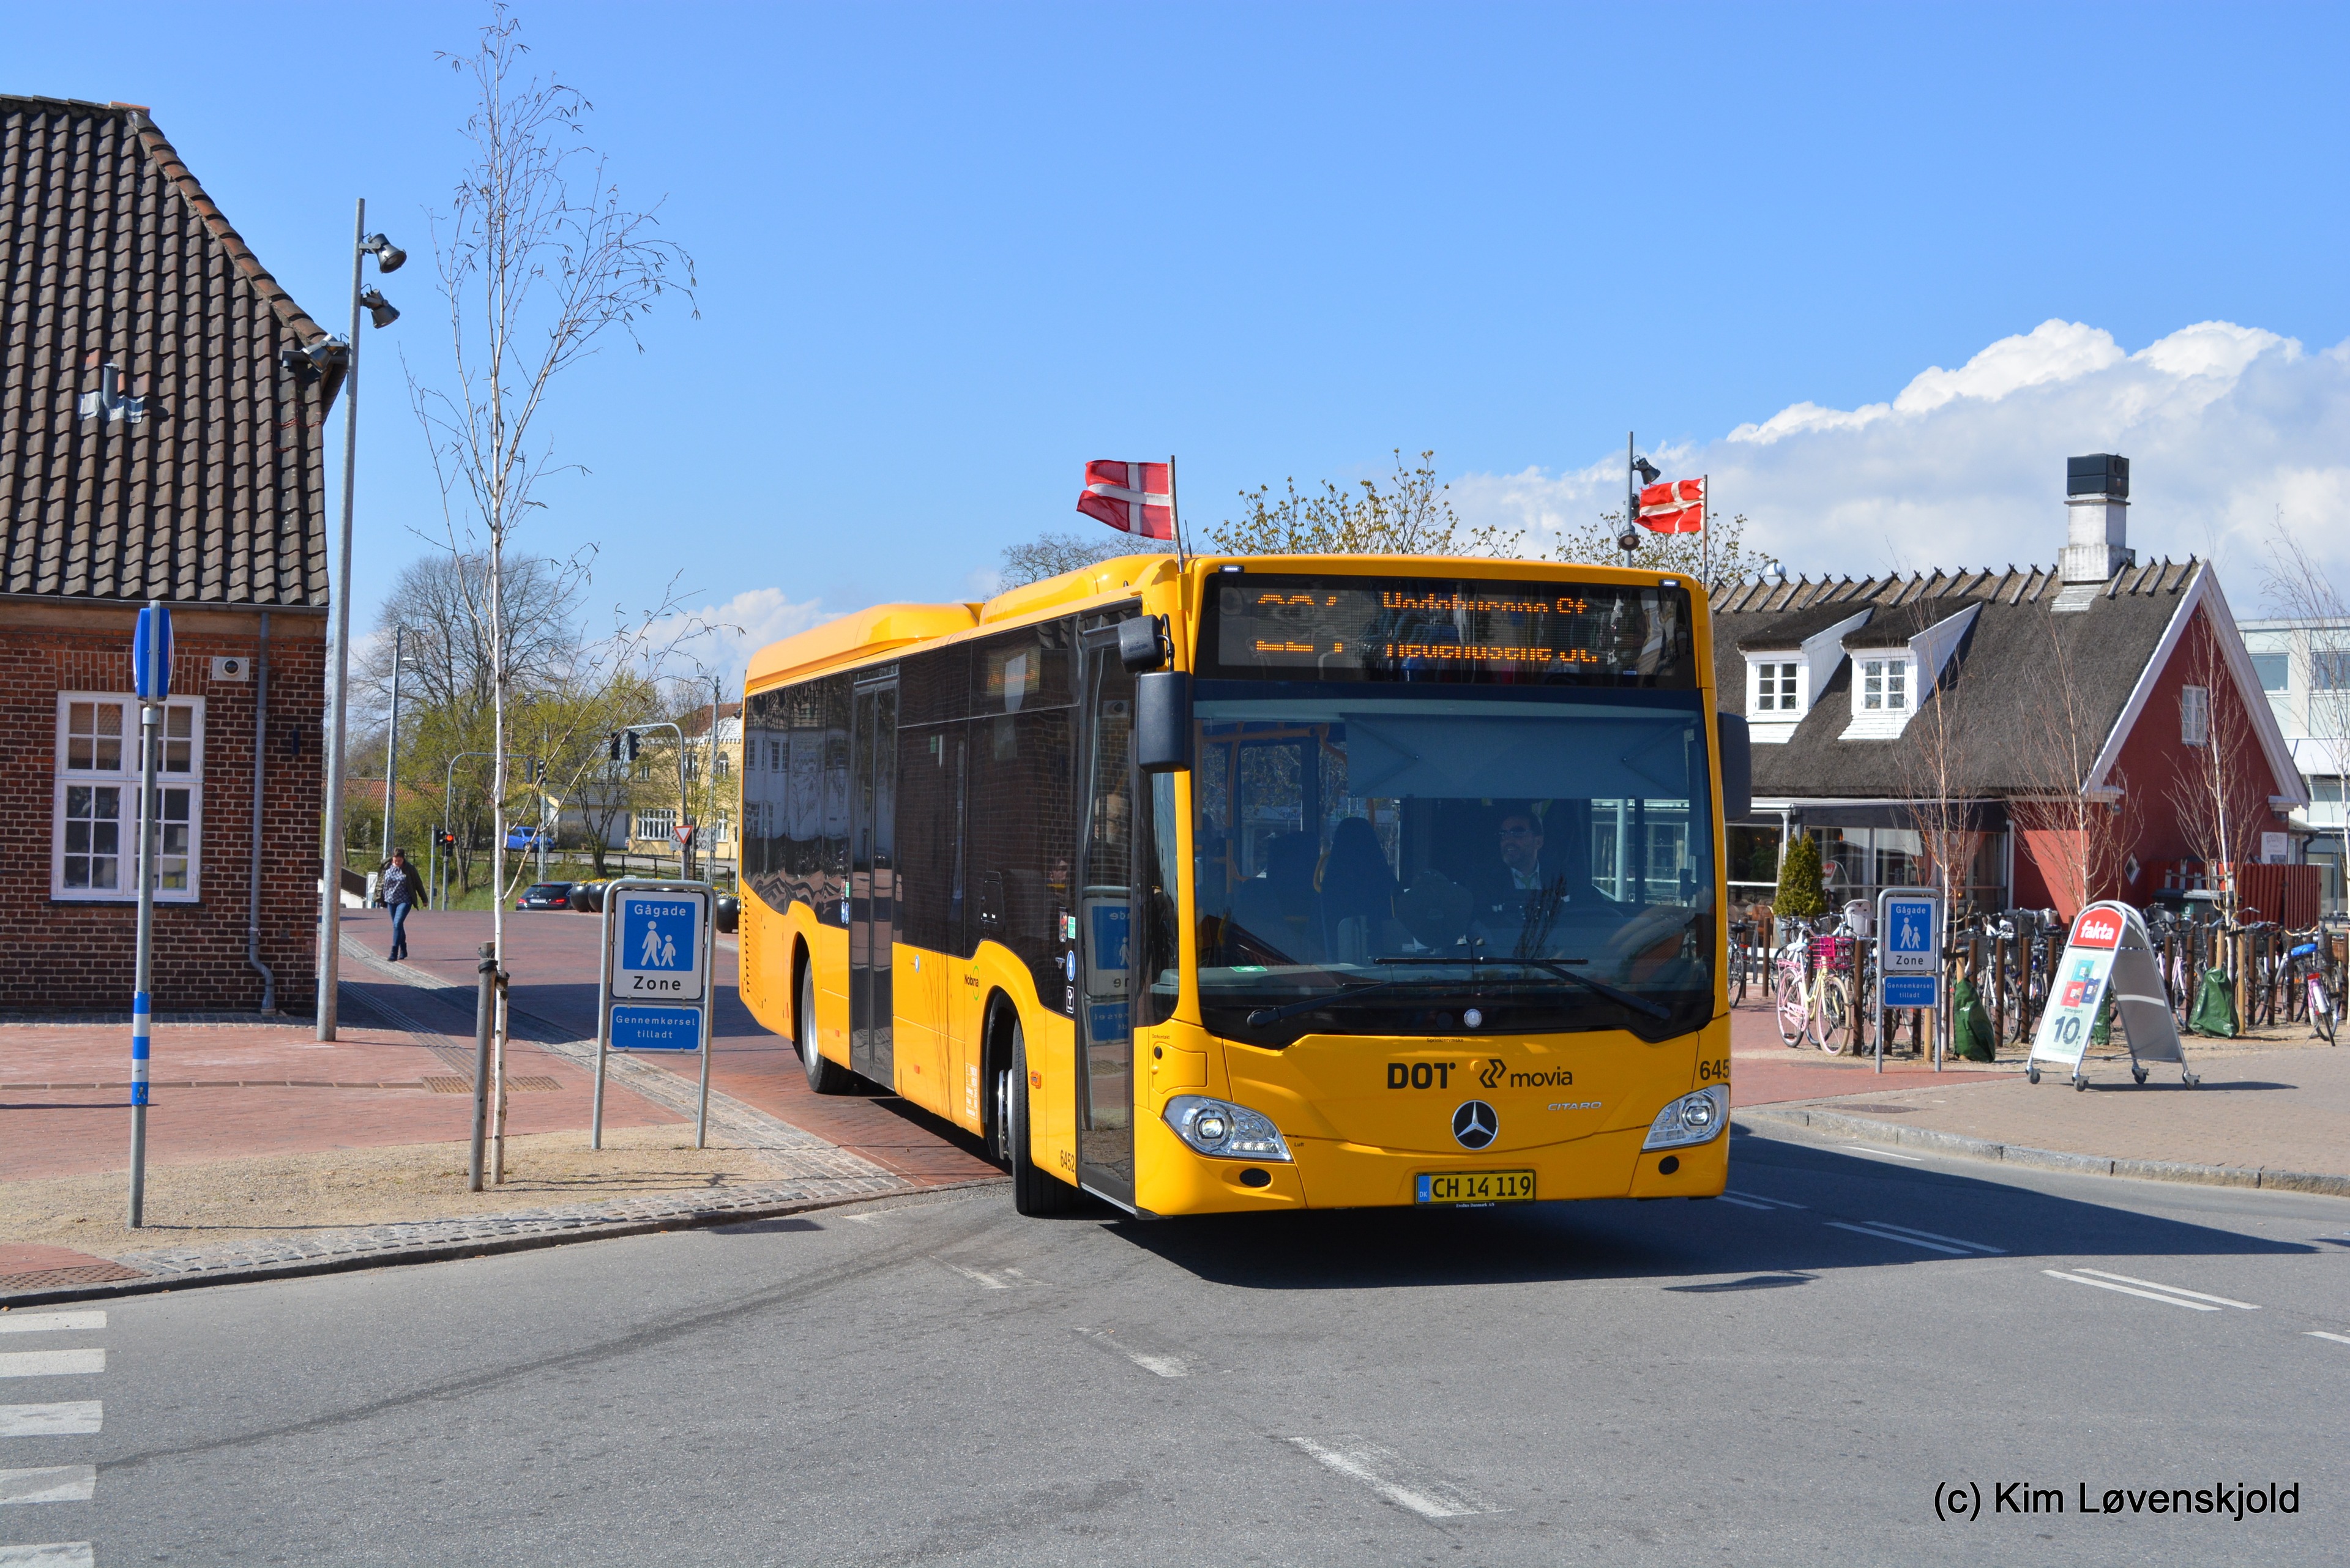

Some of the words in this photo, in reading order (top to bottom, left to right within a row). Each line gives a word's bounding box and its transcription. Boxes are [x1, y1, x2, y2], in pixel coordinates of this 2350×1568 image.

[634, 904, 686, 917] Gågade
[1896, 906, 1926, 915] Gågade
[2080, 919, 2114, 940] fakta
[1896, 955, 1923, 965] Zone
[633, 976, 681, 990] Zone
[616, 1015, 696, 1026] Gennemkørsel
[637, 1029, 673, 1039] tilladt
[1387, 1062, 1456, 1089] DOT
[1510, 1066, 1573, 1088] movia
[1547, 1102, 1602, 1111] CITARO
[1061, 1149, 1075, 1173] 6452
[1432, 1178, 1459, 1198] CH
[1466, 1177, 1488, 1197] 14
[1496, 1176, 1531, 1197] 119
